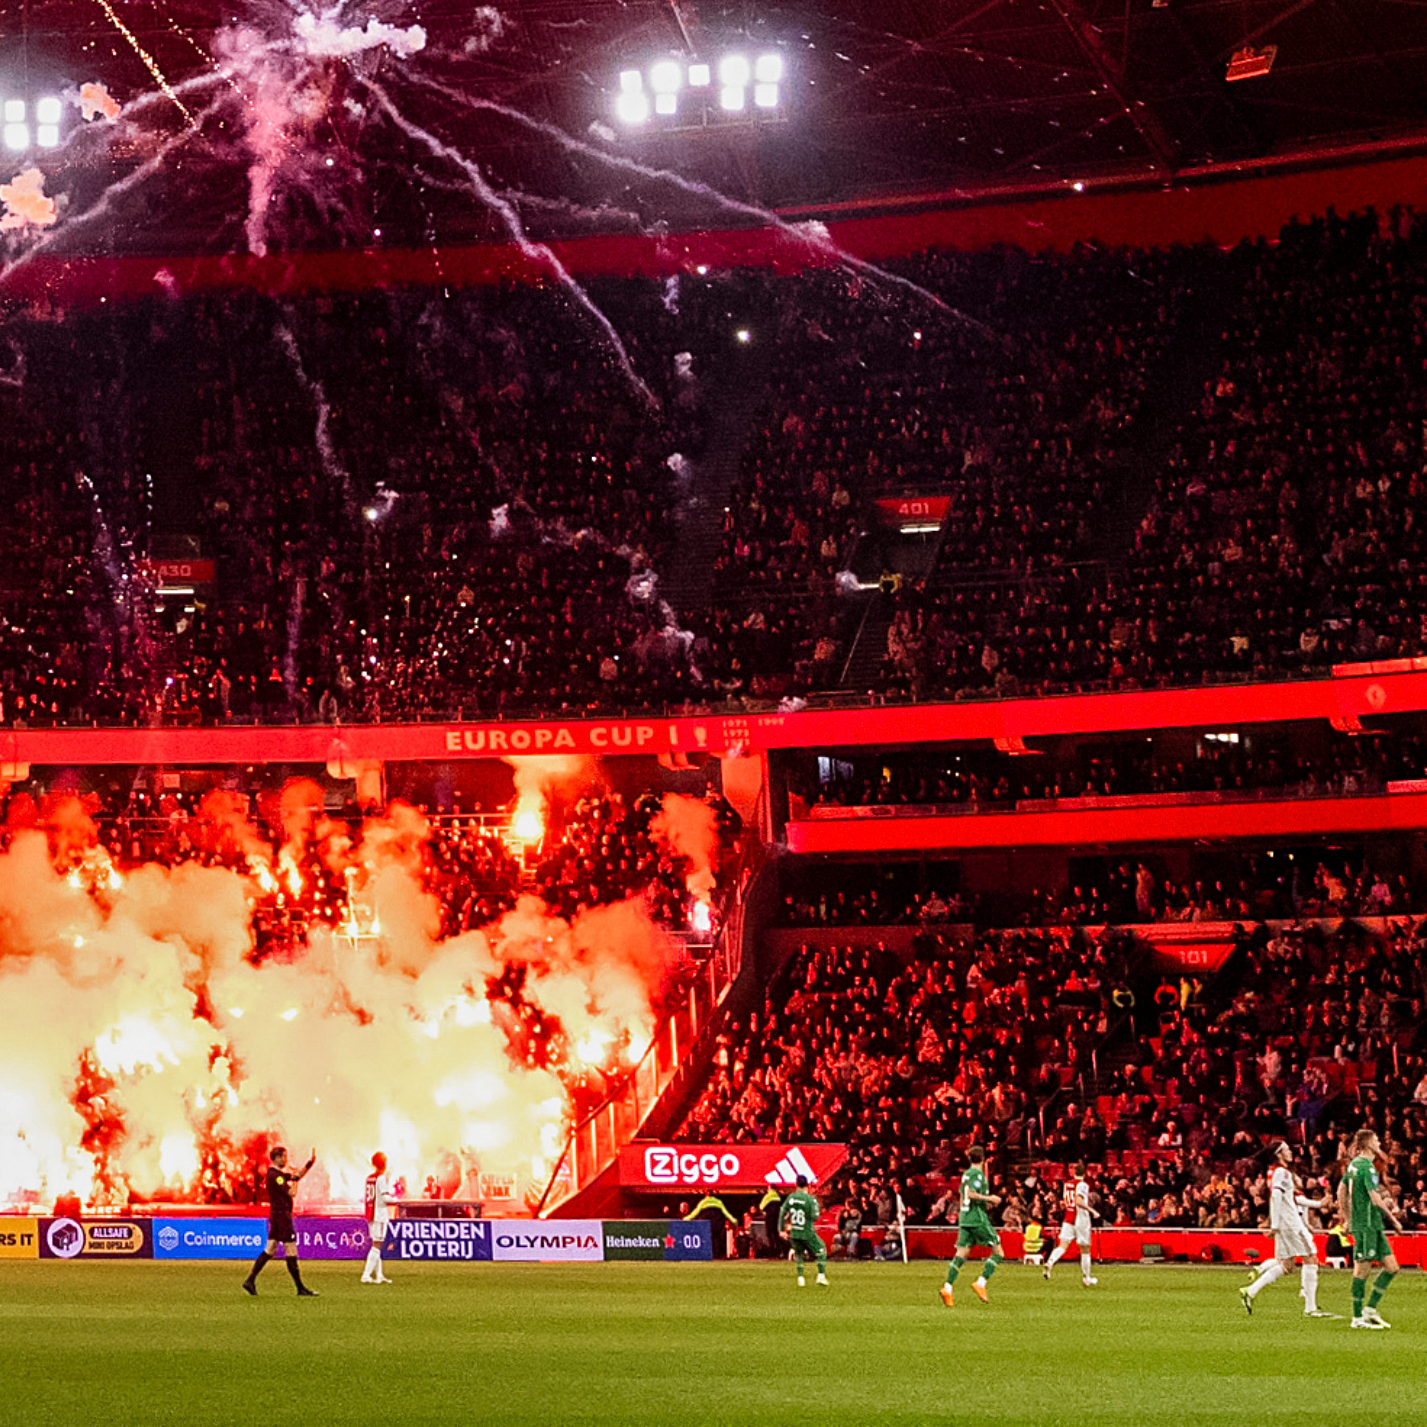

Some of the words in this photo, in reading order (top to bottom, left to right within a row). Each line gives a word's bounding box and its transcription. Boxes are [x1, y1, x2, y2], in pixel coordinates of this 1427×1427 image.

[898, 502, 930, 515] 401
[445, 727, 576, 751] EUROPA
[589, 725, 655, 748] CUP
[669, 725, 679, 745] I
[789, 1207, 806, 1226] 26
[92, 1227, 129, 1238] ALLSAFE
[183, 1231, 263, 1247] Coinmerce
[388, 1222, 485, 1241] VRIENDEN
[20, 1233, 34, 1246] IT
[495, 1235, 599, 1249] OLYMPIA
[605, 1235, 661, 1248] Heineken
[401, 1241, 474, 1260] LOTERIJ
